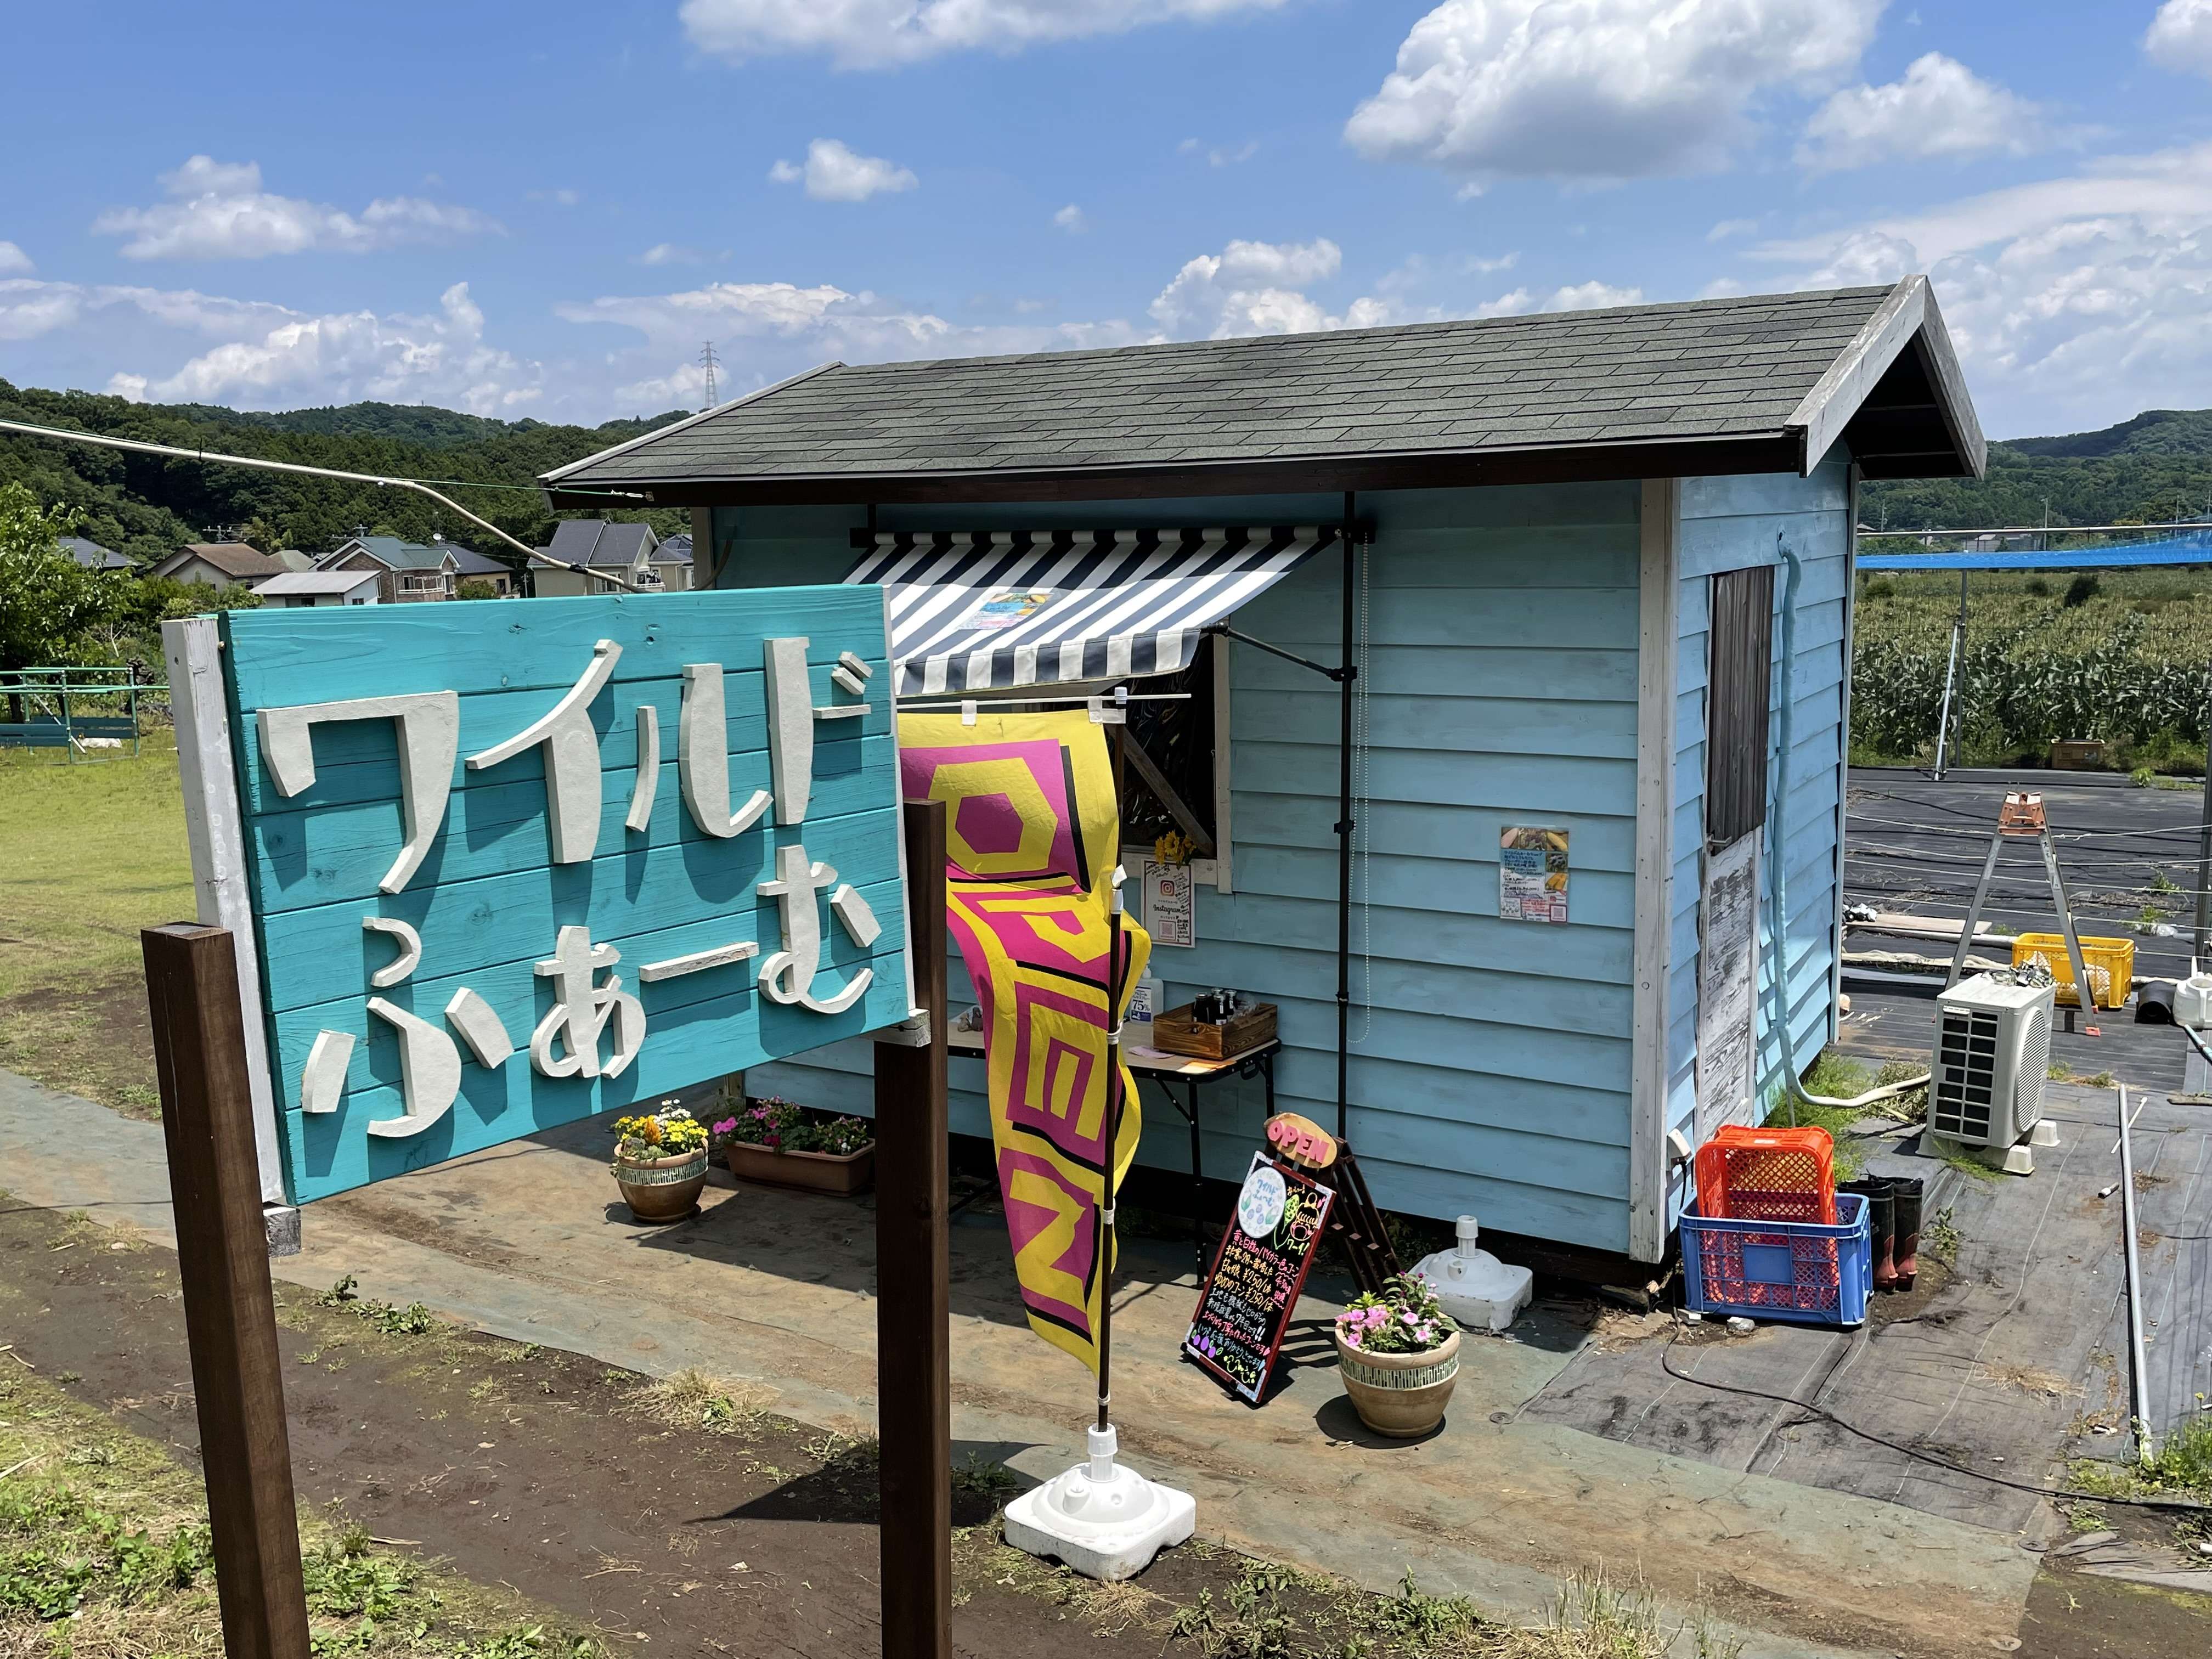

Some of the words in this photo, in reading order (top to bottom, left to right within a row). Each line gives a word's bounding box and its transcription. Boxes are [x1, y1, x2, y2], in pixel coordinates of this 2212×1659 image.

[257, 638, 873, 894] ワイルド
[1153, 904, 1181, 915] Instagram
[302, 845, 881, 1137] ふぁーむ
[928, 756, 1109, 1311] OPEN
[1132, 1000, 1150, 1011] 75%
[1267, 1121, 1330, 1164] OPEN
